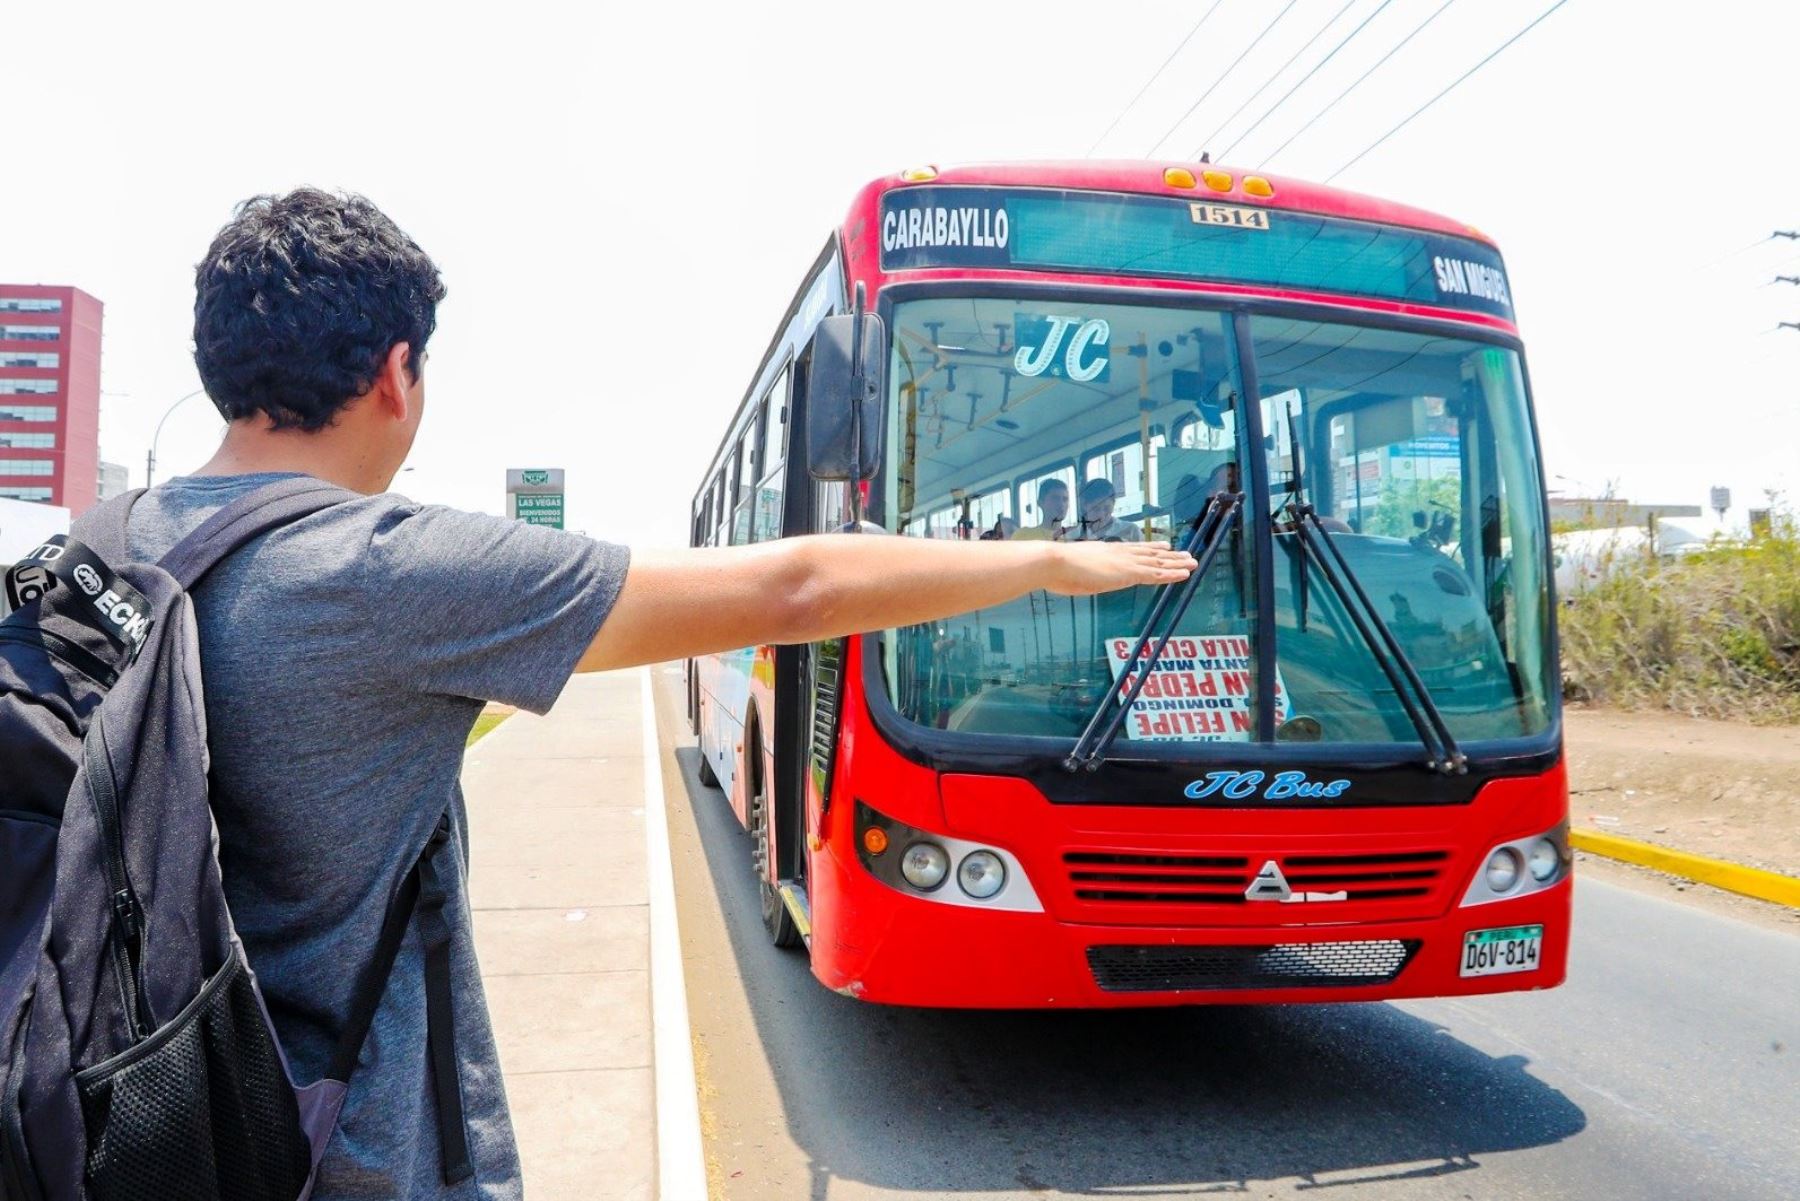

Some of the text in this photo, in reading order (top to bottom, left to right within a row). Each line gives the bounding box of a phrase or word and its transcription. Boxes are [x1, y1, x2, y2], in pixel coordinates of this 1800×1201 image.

[1196, 206, 1263, 227] 1514
[883, 207, 1009, 252] CARABAYLLO
[1434, 256, 1468, 294] SAN
[518, 499, 561, 507] LAS VEGAS
[1113, 639, 1131, 660] 3
[1200, 639, 1250, 658] ILLA
[1199, 659, 1250, 671] ANTA
[1133, 698, 1234, 710] DOMINGO
[1133, 711, 1226, 736] FELIPE
[1184, 770, 1351, 799] JC Bus
[1466, 938, 1537, 970] D6V-814
